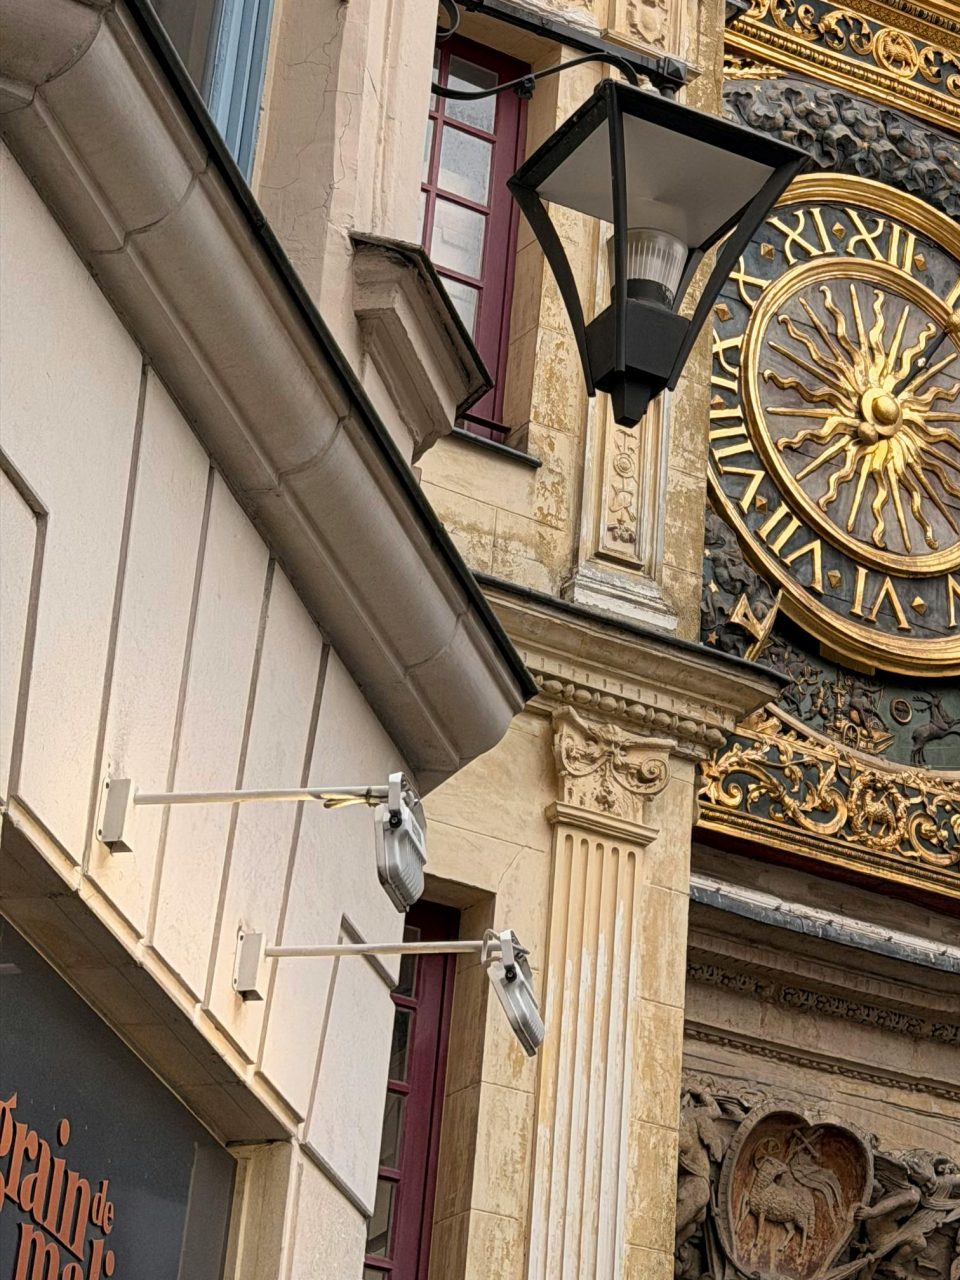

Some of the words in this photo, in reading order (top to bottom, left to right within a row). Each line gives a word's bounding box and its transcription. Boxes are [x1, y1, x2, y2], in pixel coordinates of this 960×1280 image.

[766, 207, 835, 265] XI
[844, 207, 917, 276] XII
[729, 255, 772, 311] X
[755, 500, 824, 596] VII
[850, 565, 912, 632] VI
[91, 1179, 114, 1235] de
